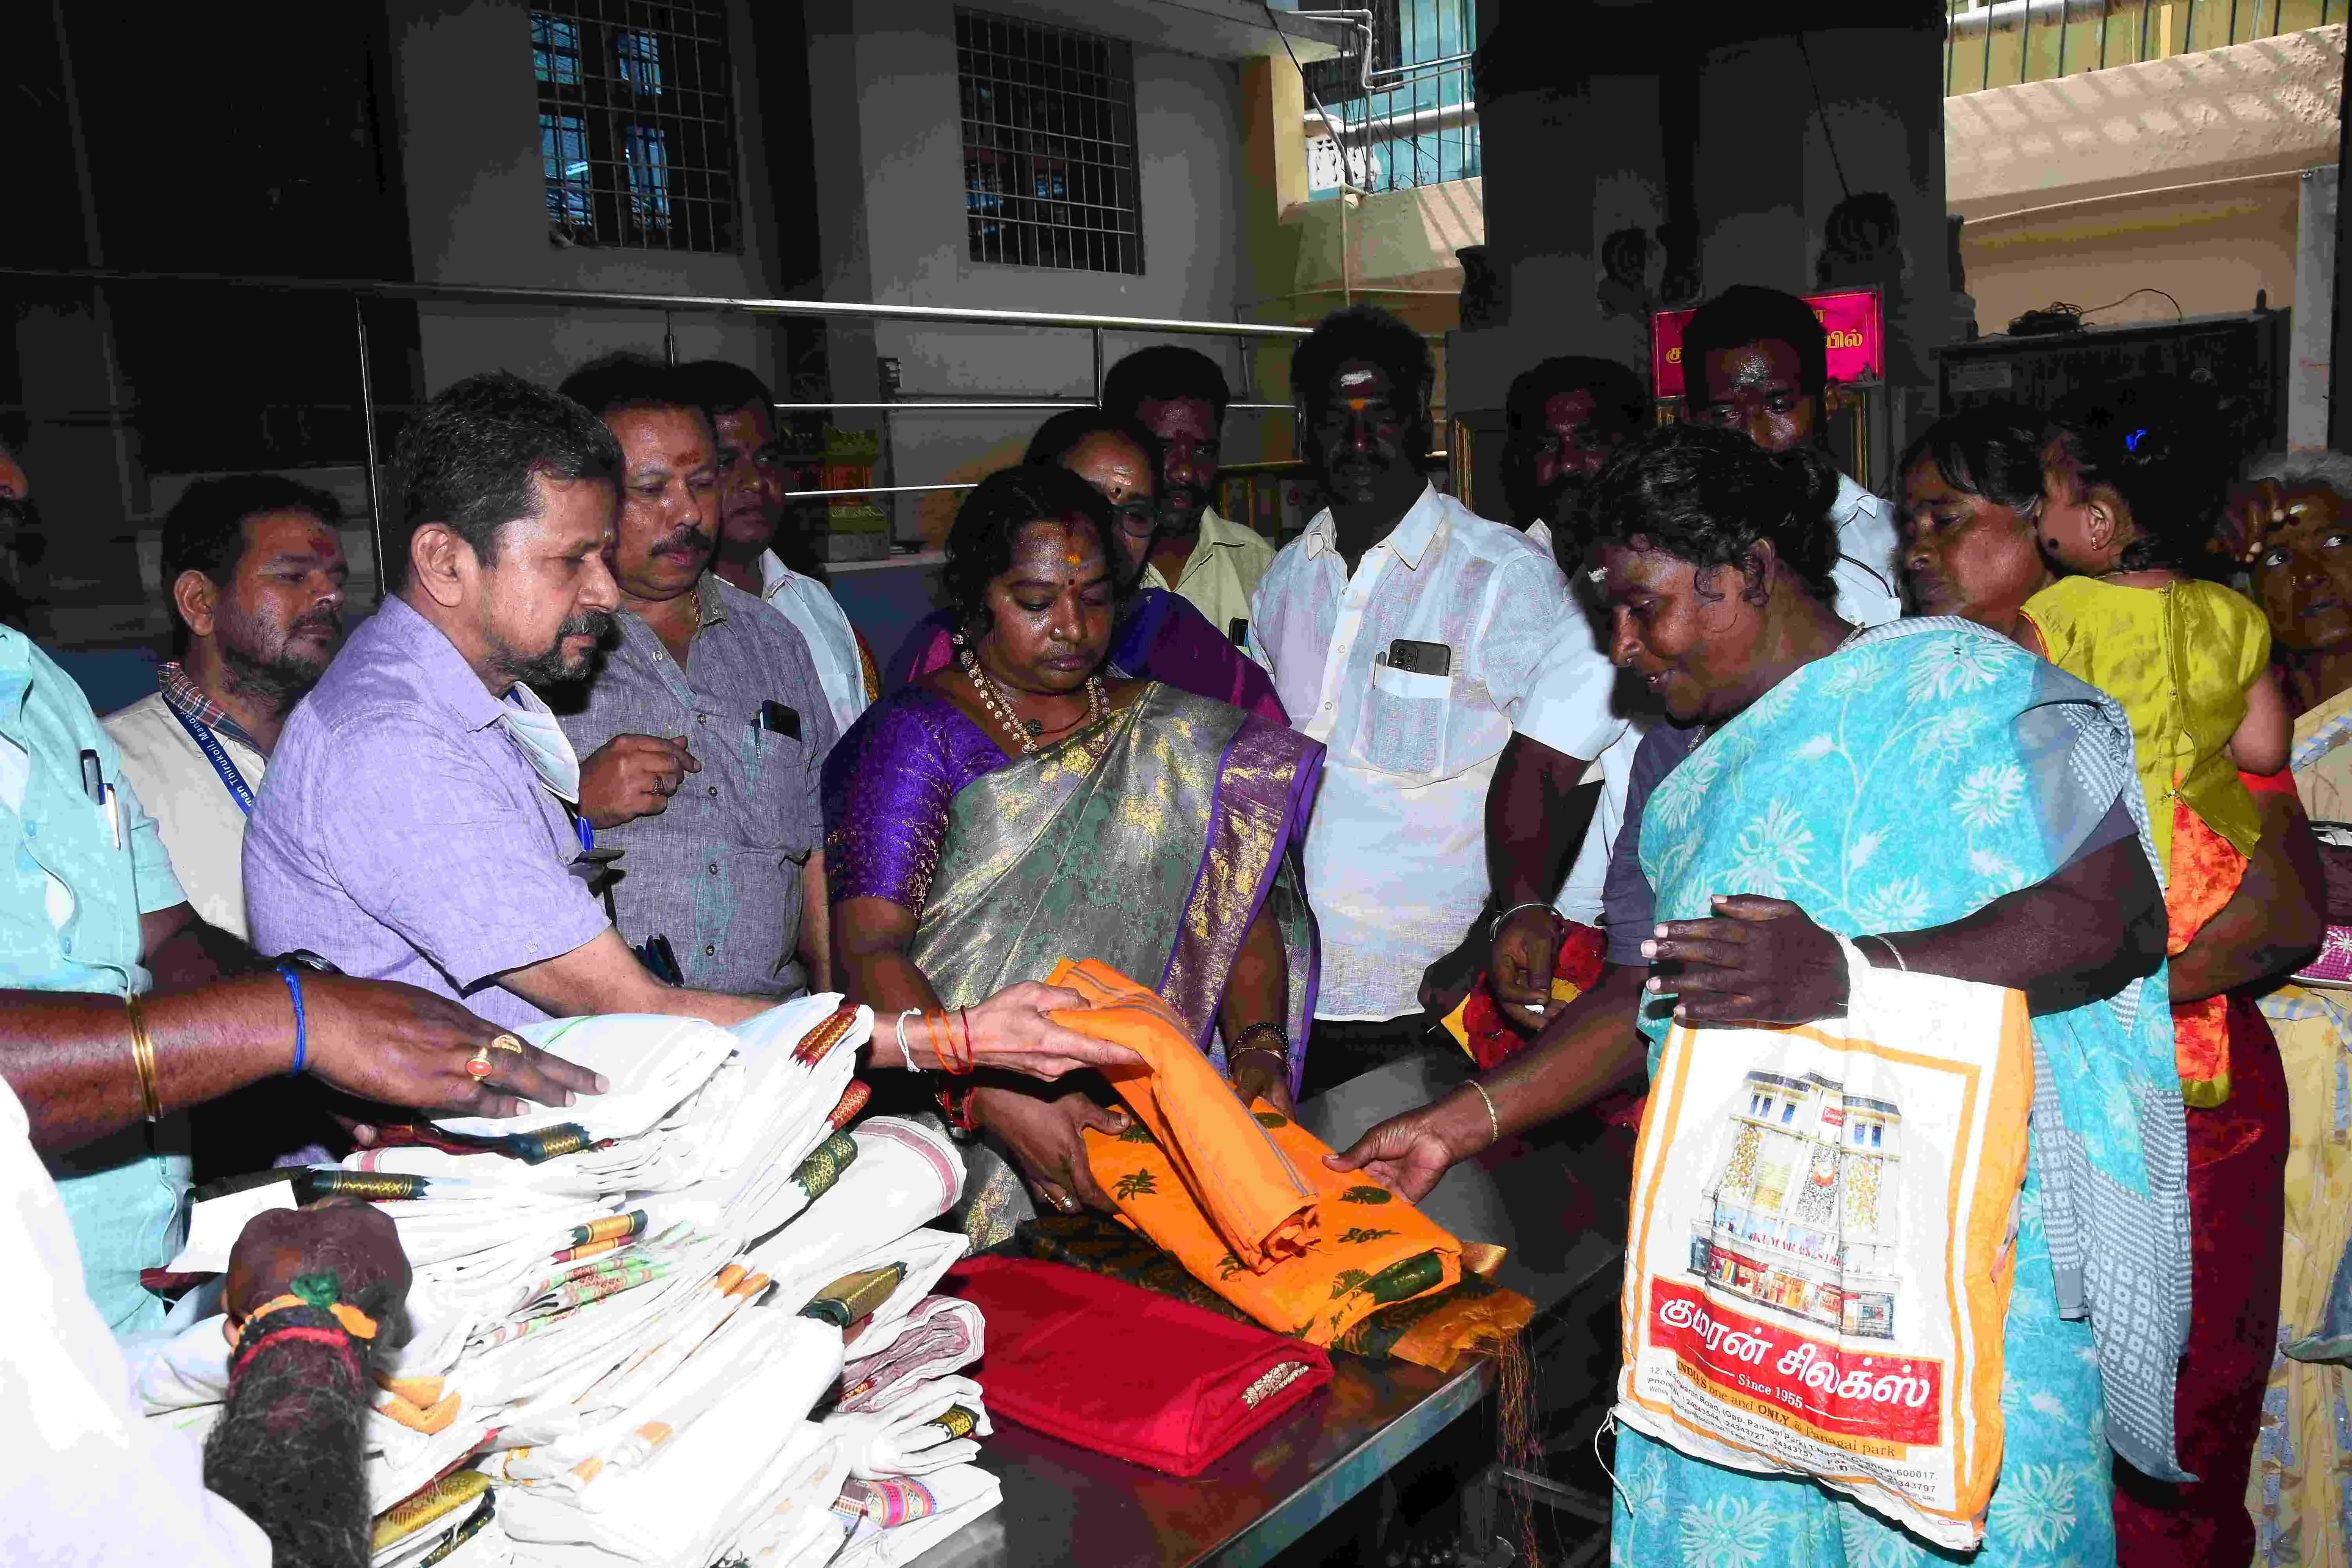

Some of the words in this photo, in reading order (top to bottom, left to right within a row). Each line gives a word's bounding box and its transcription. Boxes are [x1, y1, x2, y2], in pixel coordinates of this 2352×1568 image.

[1659, 1298, 1773, 1365] குமரன்
[1738, 1374, 1771, 1395] Since
[1775, 1387, 1802, 1409] 1955
[1731, 1396, 1753, 1411] and
[1758, 1405, 1790, 1425] ONLY
[1862, 1445, 1895, 1456] park
